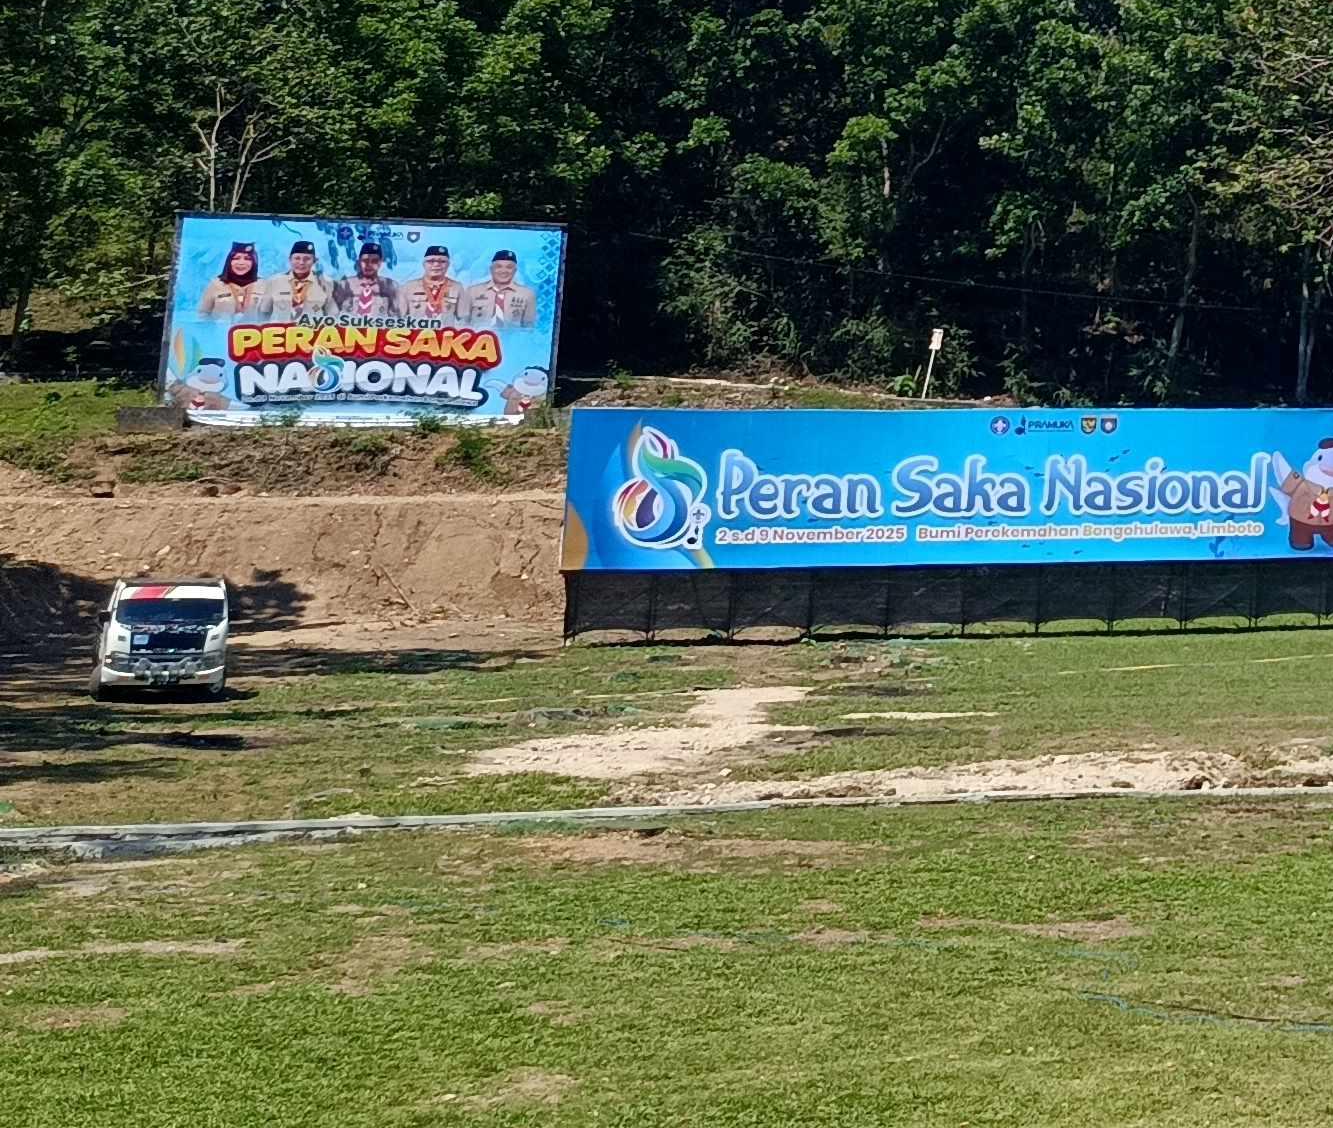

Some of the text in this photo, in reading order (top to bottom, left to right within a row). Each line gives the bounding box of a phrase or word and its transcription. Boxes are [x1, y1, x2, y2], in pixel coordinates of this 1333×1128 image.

[299, 313, 442, 329] Ayo Sukseskan
[232, 326, 498, 363] PERAN SAKA
[1028, 420, 1074, 429] PRAMUKA
[718, 450, 1269, 518] Peran Saka Nasional
[717, 529, 727, 542] 2
[759, 529, 769, 542] 9
[772, 527, 862, 542] November
[866, 527, 905, 541] 2025
[918, 525, 961, 540] Bumi
